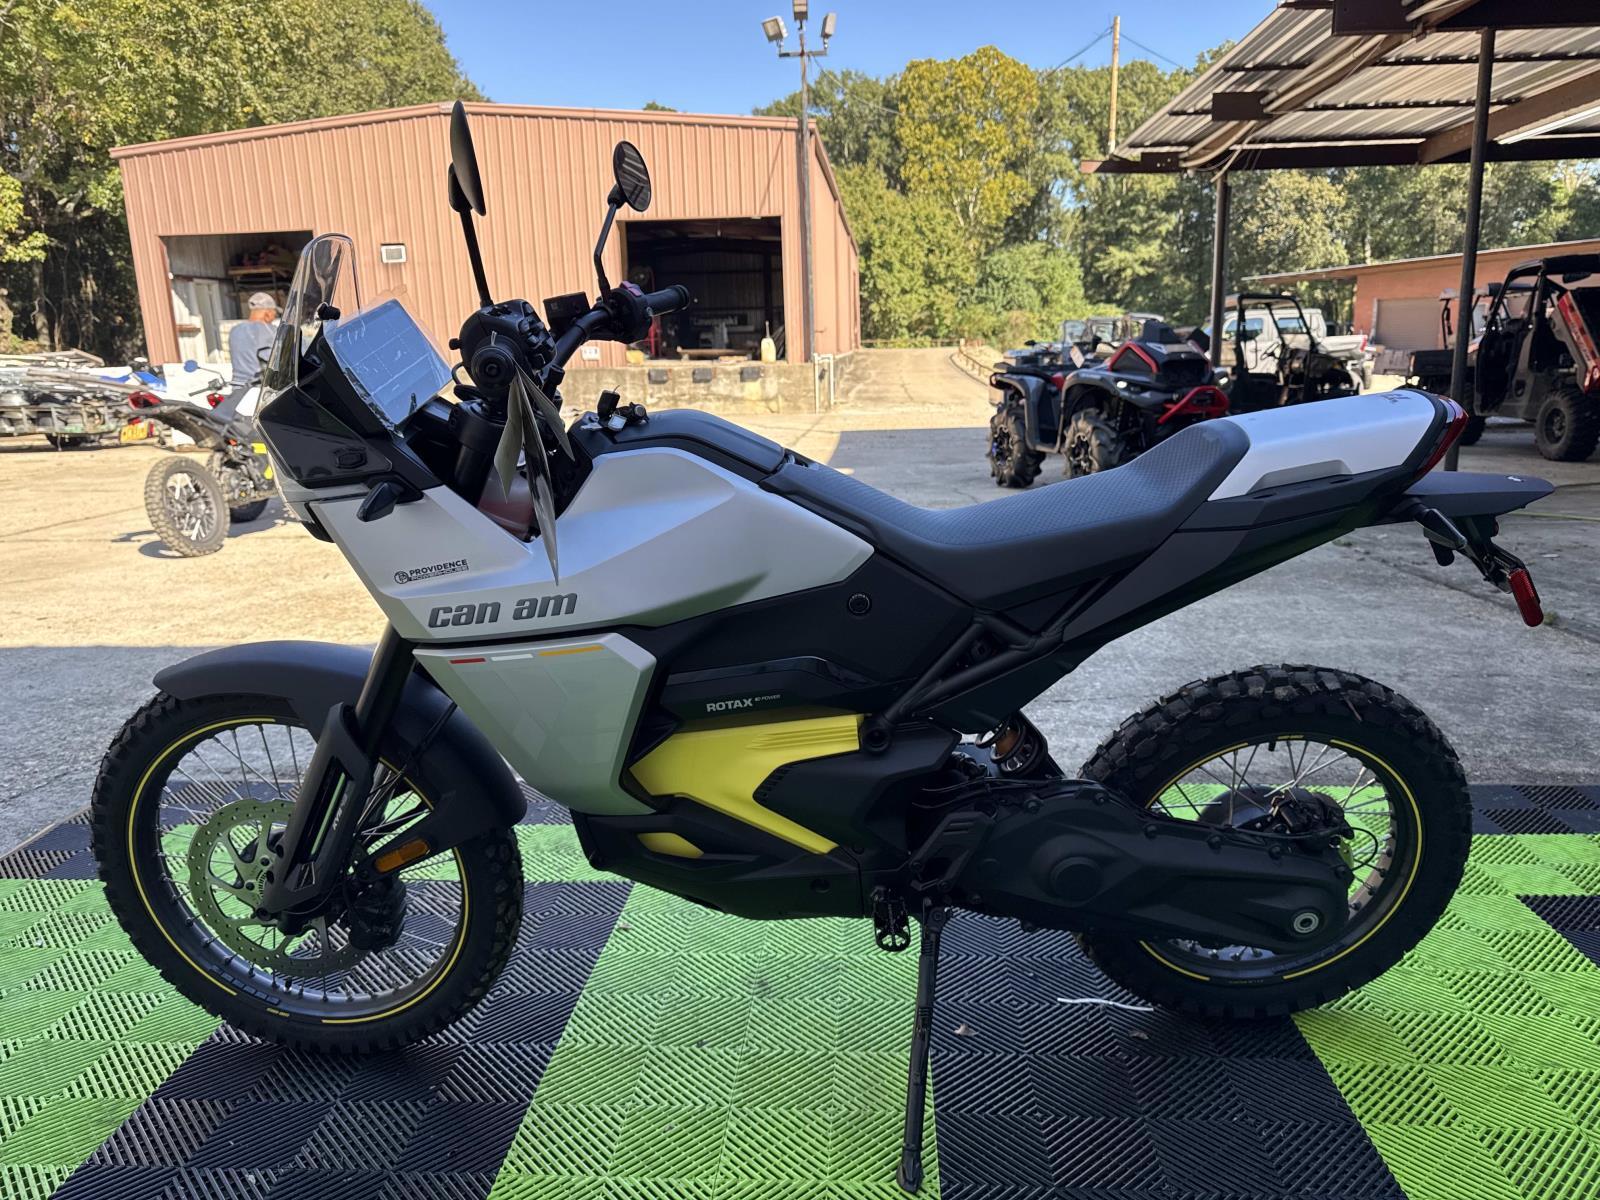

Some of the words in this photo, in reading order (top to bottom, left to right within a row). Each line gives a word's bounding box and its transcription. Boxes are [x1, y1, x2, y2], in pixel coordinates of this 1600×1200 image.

[409, 559, 468, 576] PROVIDENCE
[428, 602, 501, 628] can
[512, 592, 578, 621] am
[706, 698, 753, 712] ROTAX
